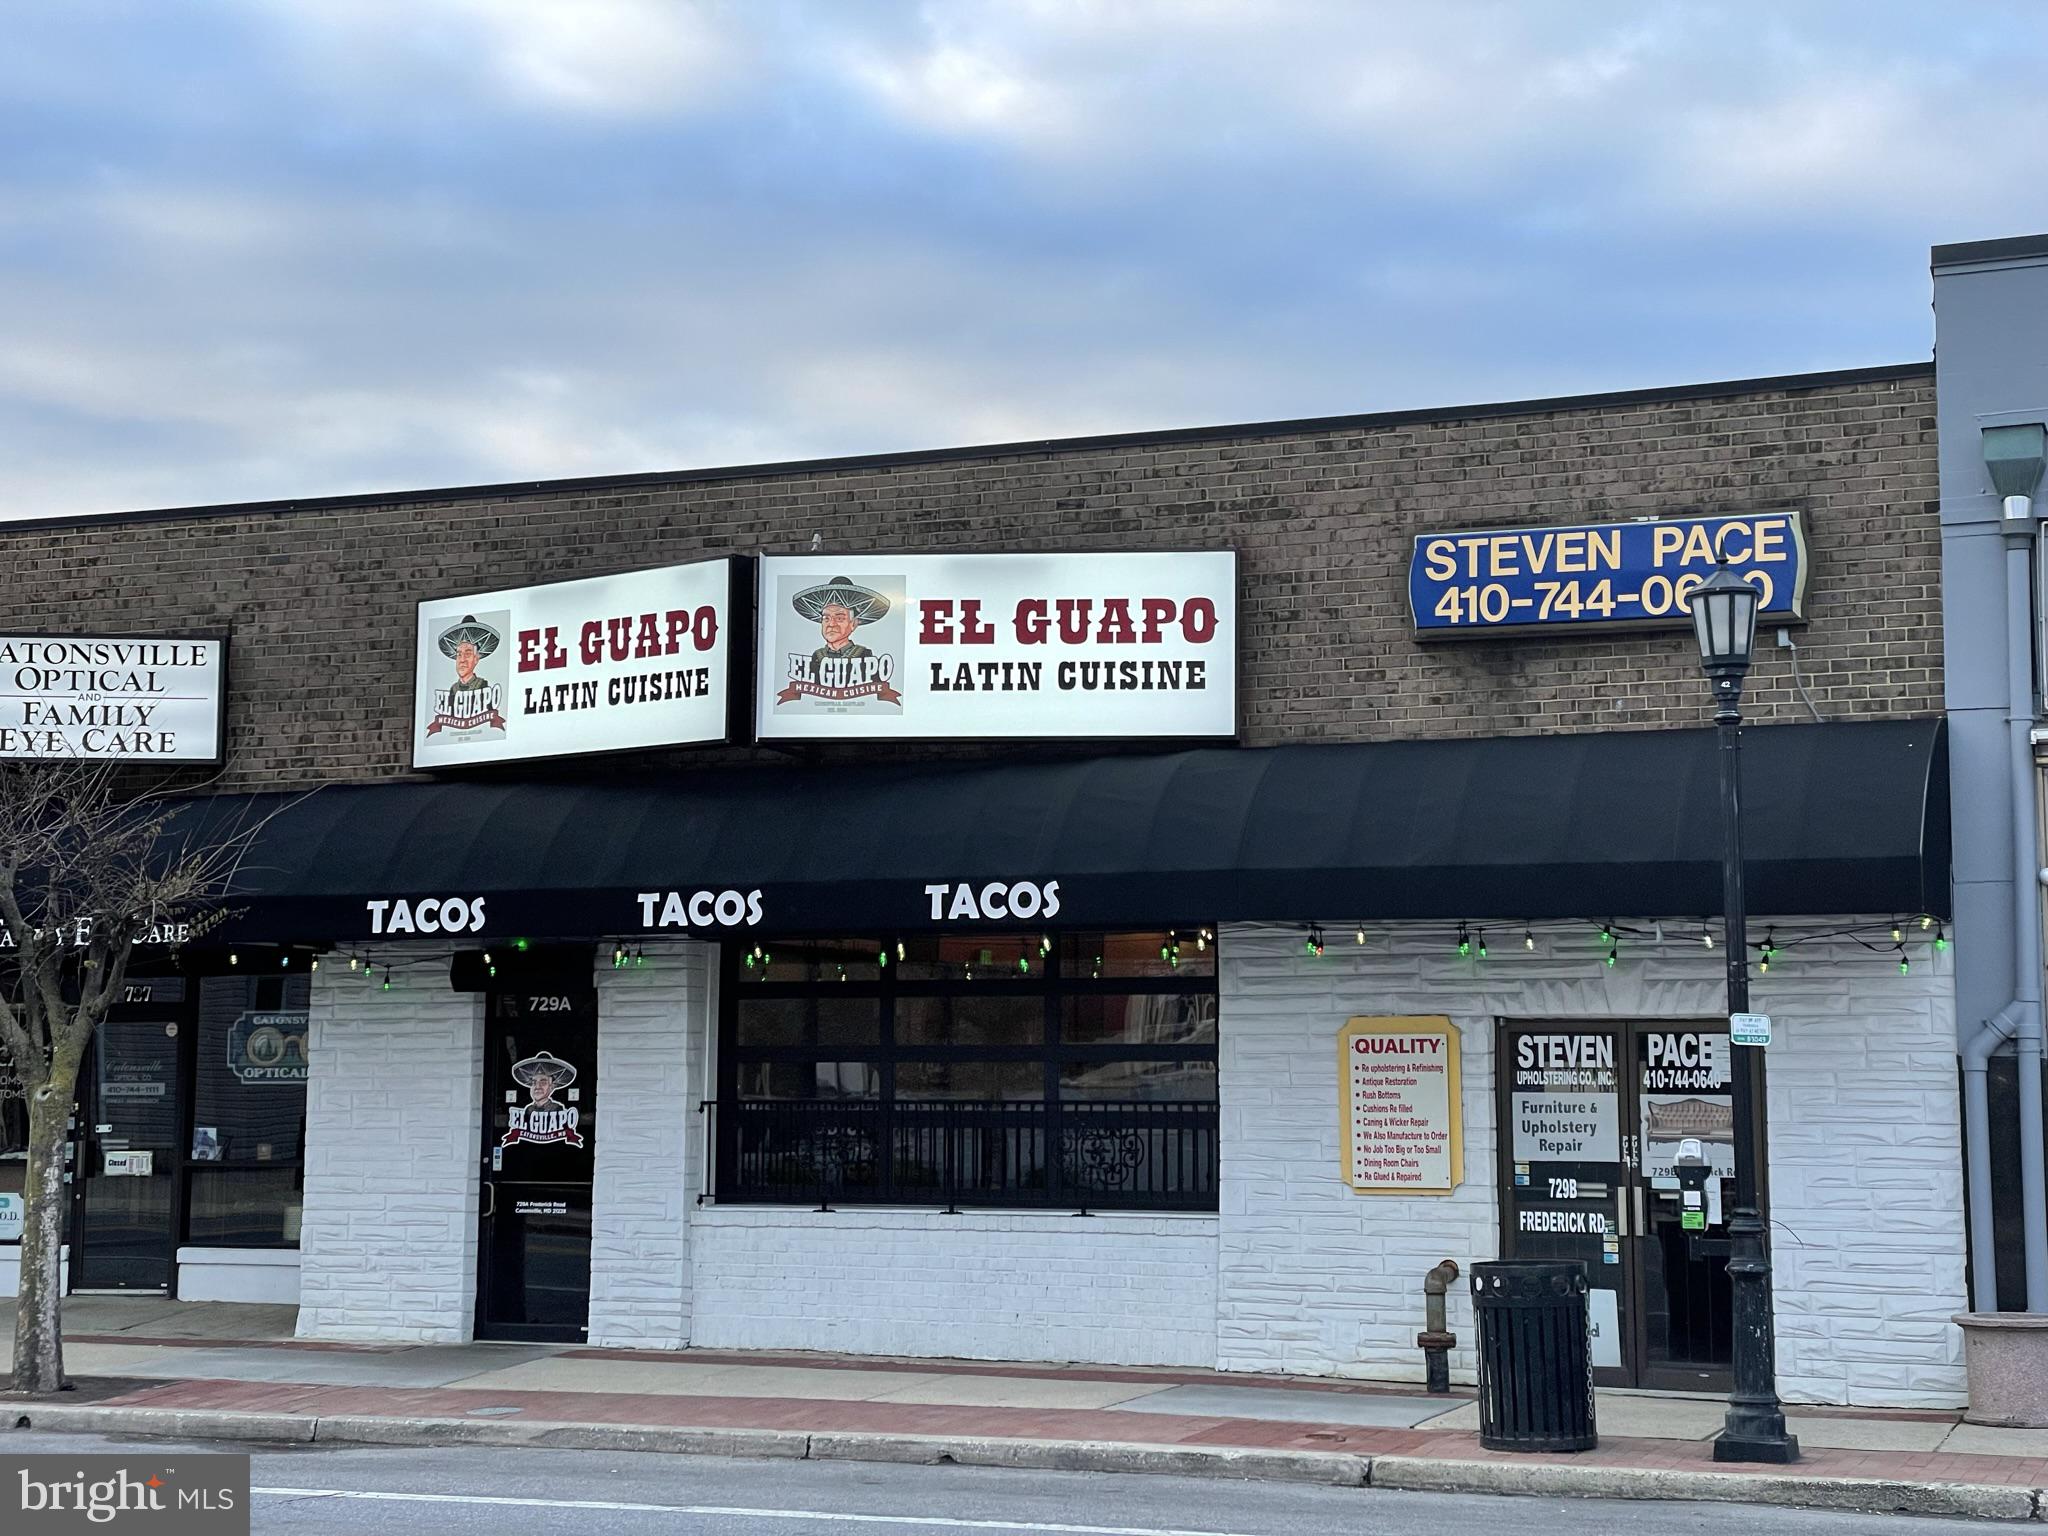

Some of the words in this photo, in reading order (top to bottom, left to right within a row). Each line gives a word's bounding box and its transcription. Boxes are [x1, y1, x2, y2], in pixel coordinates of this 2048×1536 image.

[1424, 528, 1621, 582] STEVEN
[1653, 518, 1788, 568] PACE
[1434, 569, 1774, 624] 410-744-060
[919, 598, 995, 645] EL
[1012, 596, 1218, 645] GUAPO
[517, 625, 568, 674] EL
[578, 604, 720, 667] GUAPO
[0, 642, 208, 667] ATONSVILLE
[14, 666, 165, 693] OPTICAL
[787, 652, 816, 683] EL
[818, 653, 895, 688] GUAPO
[929, 661, 1043, 691] LATIN
[1057, 659, 1206, 690] CUISINE
[77, 693, 102, 702] AND
[523, 680, 599, 716] LATIN
[607, 666, 710, 706] CUISINE
[795, 683, 837, 697] MEXICAN
[843, 684, 883, 697] CUISINE
[434, 689, 452, 716] EL
[453, 682, 503, 719] GUAPO
[23, 701, 158, 727] FAMILY
[438, 717, 465, 727] MEXICAN
[468, 712, 494, 727] CUISINE
[0, 728, 64, 752] EYE
[82, 728, 177, 754] CARE
[637, 889, 763, 927] TACOS
[925, 880, 1060, 920] TACOS
[367, 896, 486, 934] TACOS
[529, 996, 572, 1012] 729A
[1354, 1038, 1441, 1054] QUALITY
[1517, 1035, 1613, 1068] STEVEN
[1648, 1033, 1713, 1067] PACE
[243, 1067, 309, 1078] OPTICAL
[1362, 1064, 1369, 1072] Re
[1371, 1064, 1405, 1073] upholstering
[1412, 1064, 1444, 1073] Refinishing
[1516, 1070, 1578, 1086] UPHOLSTERING
[1598, 1071, 1614, 1086] INC.
[1362, 1077, 1383, 1087] Antique
[1385, 1078, 1418, 1086] Restoration
[1643, 1069, 1722, 1089] 410-744-0640
[1362, 1091, 1376, 1099] Rush
[1378, 1091, 1401, 1099] Bottoms
[1363, 1104, 1389, 1113] Cushions
[1390, 1104, 1397, 1113] Re
[1399, 1104, 1413, 1113] filled
[1521, 1100, 1586, 1115] Furniture
[1590, 1104, 1598, 1114] &
[510, 1108, 528, 1131] EL
[530, 1107, 578, 1134] GUAPO
[1363, 1118, 1382, 1128] Caning
[1384, 1118, 1388, 1127] &
[1389, 1118, 1409, 1127] Wicker
[1411, 1118, 1429, 1128] Repair
[1521, 1119, 1597, 1137] Upholstery
[1363, 1131, 1372, 1140] We
[1374, 1131, 1386, 1140] Also
[1387, 1131, 1422, 1140] Manufacture
[1424, 1132, 1429, 1140] to
[1431, 1131, 1447, 1140] Order
[1364, 1145, 1371, 1153] No
[1373, 1145, 1383, 1154] Job
[1385, 1145, 1395, 1153] Too
[1396, 1145, 1405, 1155] Big
[1414, 1145, 1425, 1154] Too
[1426, 1145, 1441, 1154] Small
[1538, 1138, 1583, 1156] Repair
[1364, 1158, 1382, 1168] Dining
[1383, 1158, 1399, 1167] Room
[1400, 1158, 1419, 1167] Chairs
[1364, 1172, 1372, 1180] Re
[1373, 1172, 1390, 1181] Glued
[1391, 1172, 1395, 1181] &
[1397, 1172, 1422, 1182] Repaired
[1548, 1178, 1578, 1199] 729B
[1519, 1211, 1586, 1233] FREDERICK
